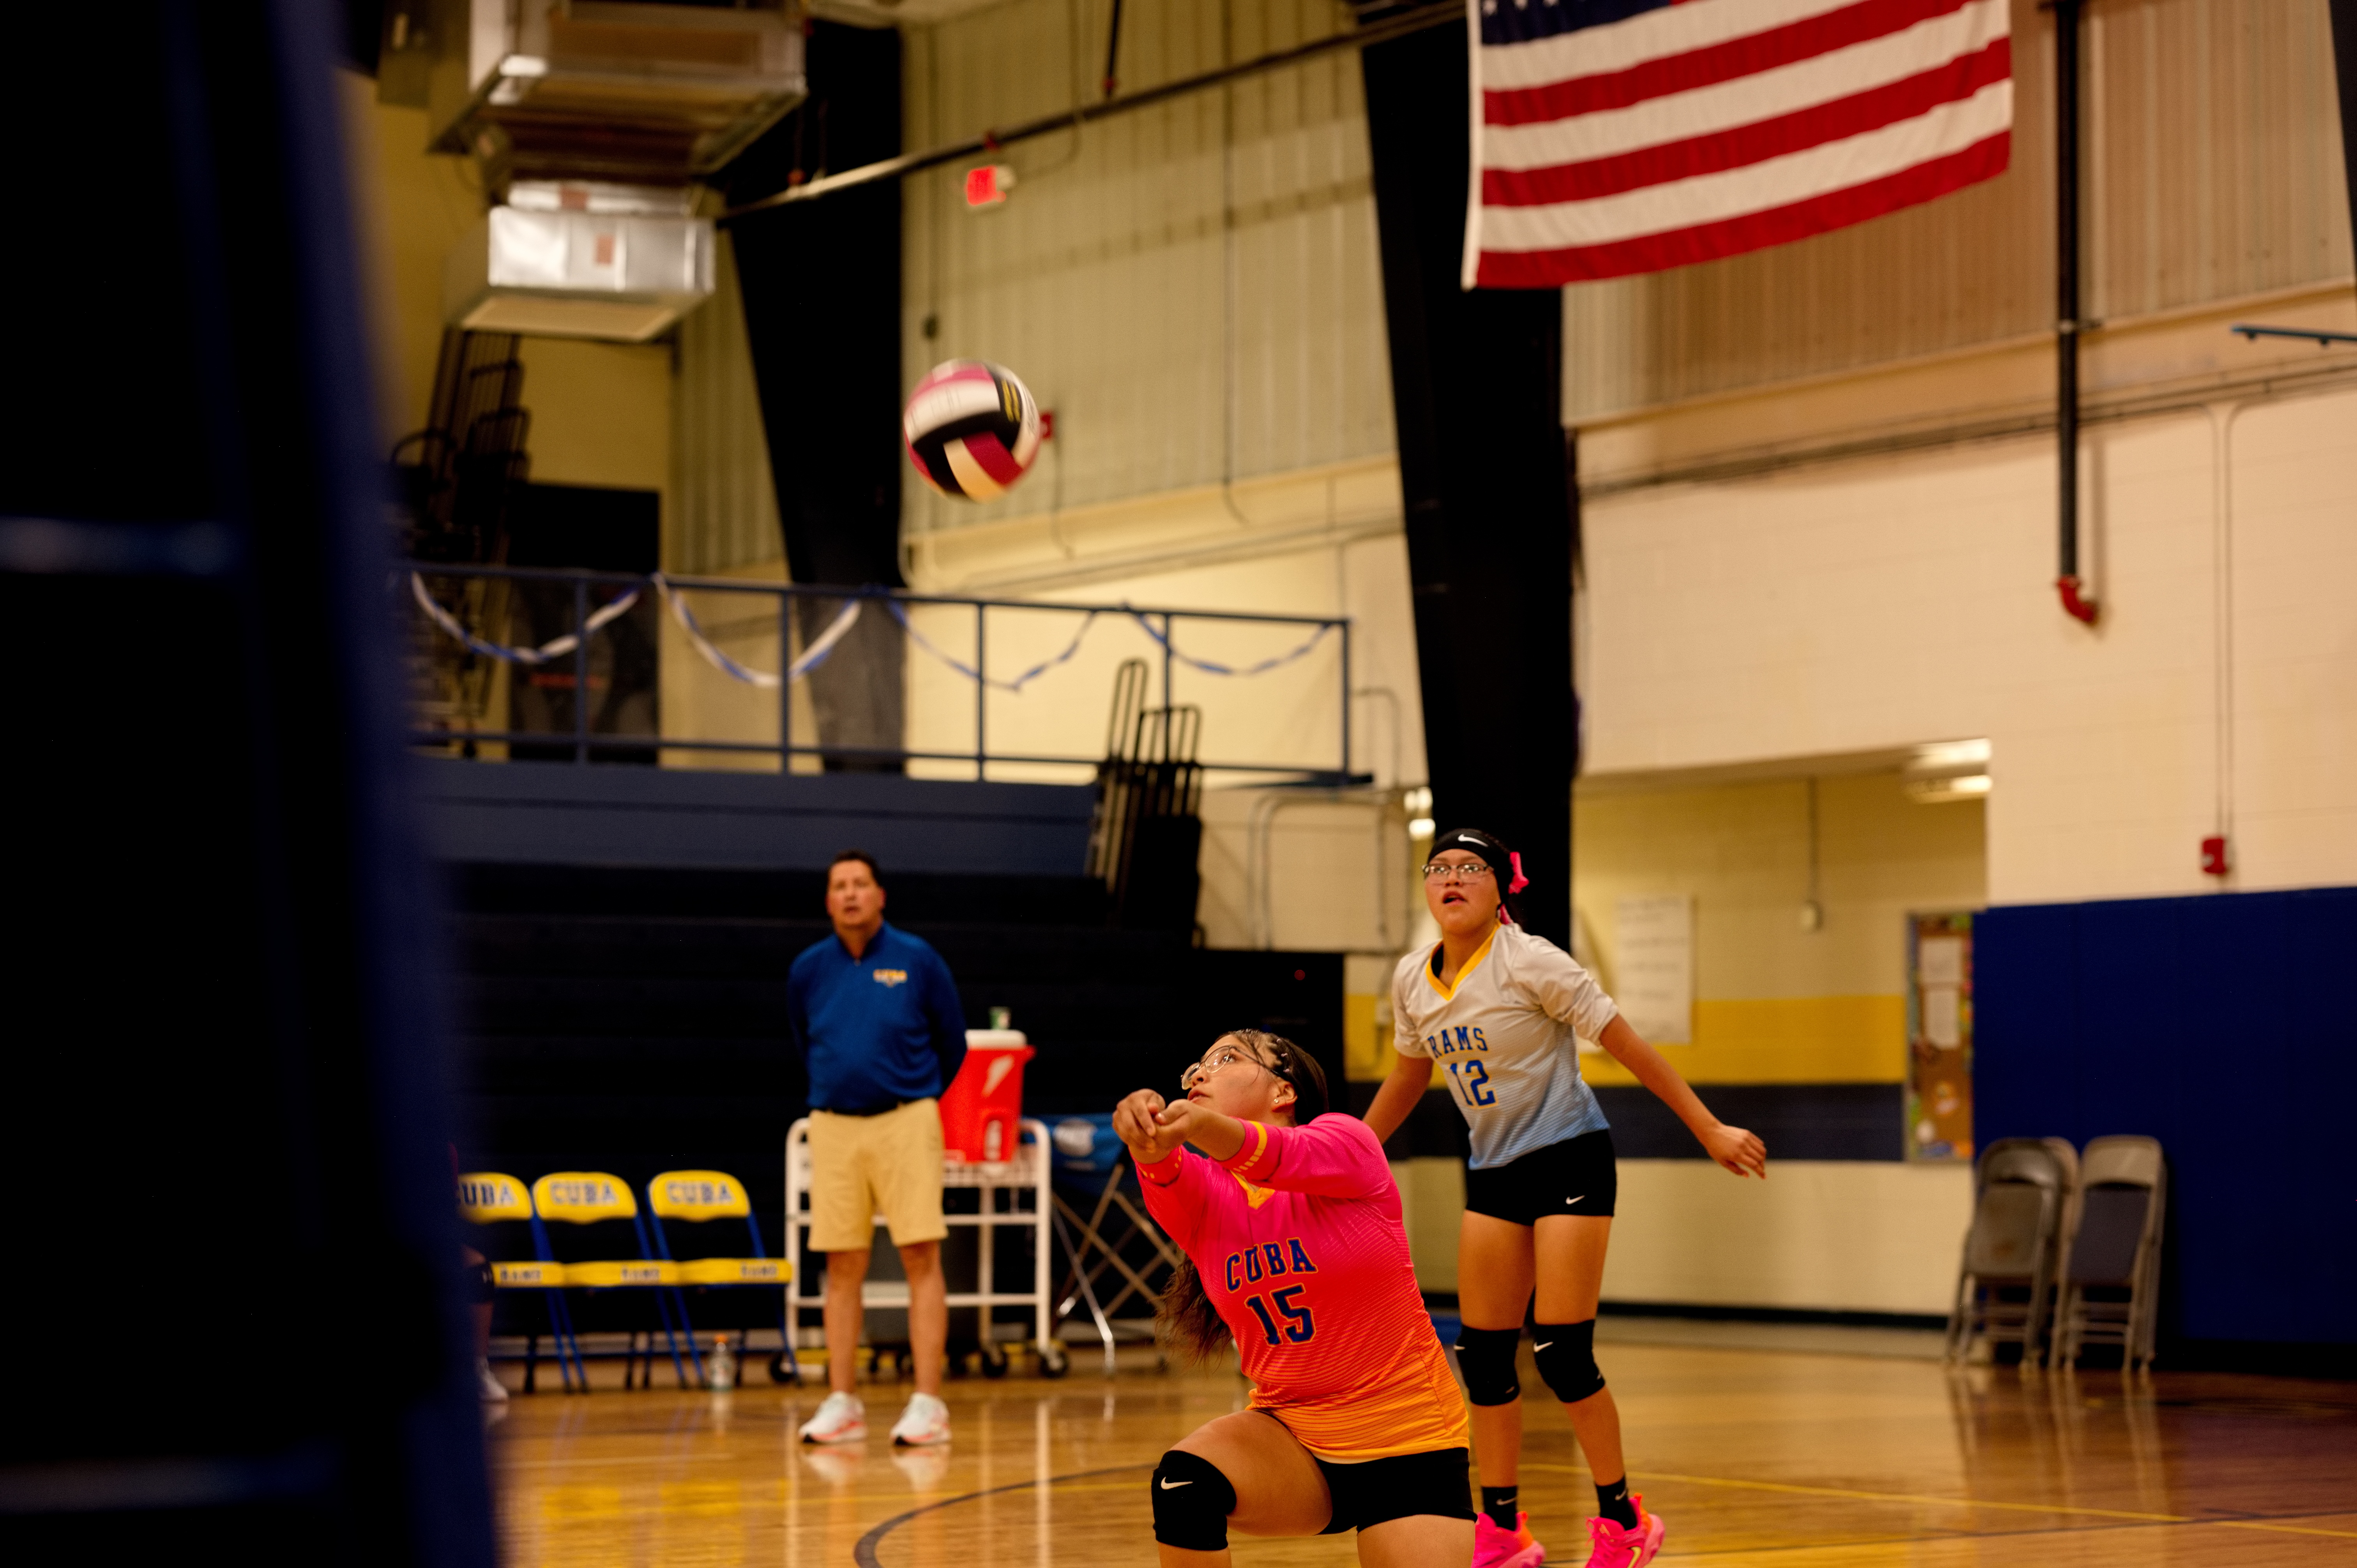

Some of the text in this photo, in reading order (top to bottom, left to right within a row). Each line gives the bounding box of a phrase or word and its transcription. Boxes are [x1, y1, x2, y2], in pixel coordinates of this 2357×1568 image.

[1426, 1025, 1489, 1059] RAMS
[1448, 1058, 1498, 1108] 12
[458, 1181, 517, 1206] UBA
[549, 1181, 619, 1205] CUBA
[665, 1180, 735, 1204] CUBA
[1225, 1237, 1318, 1293] CUBA
[1244, 1283, 1316, 1347] 15
